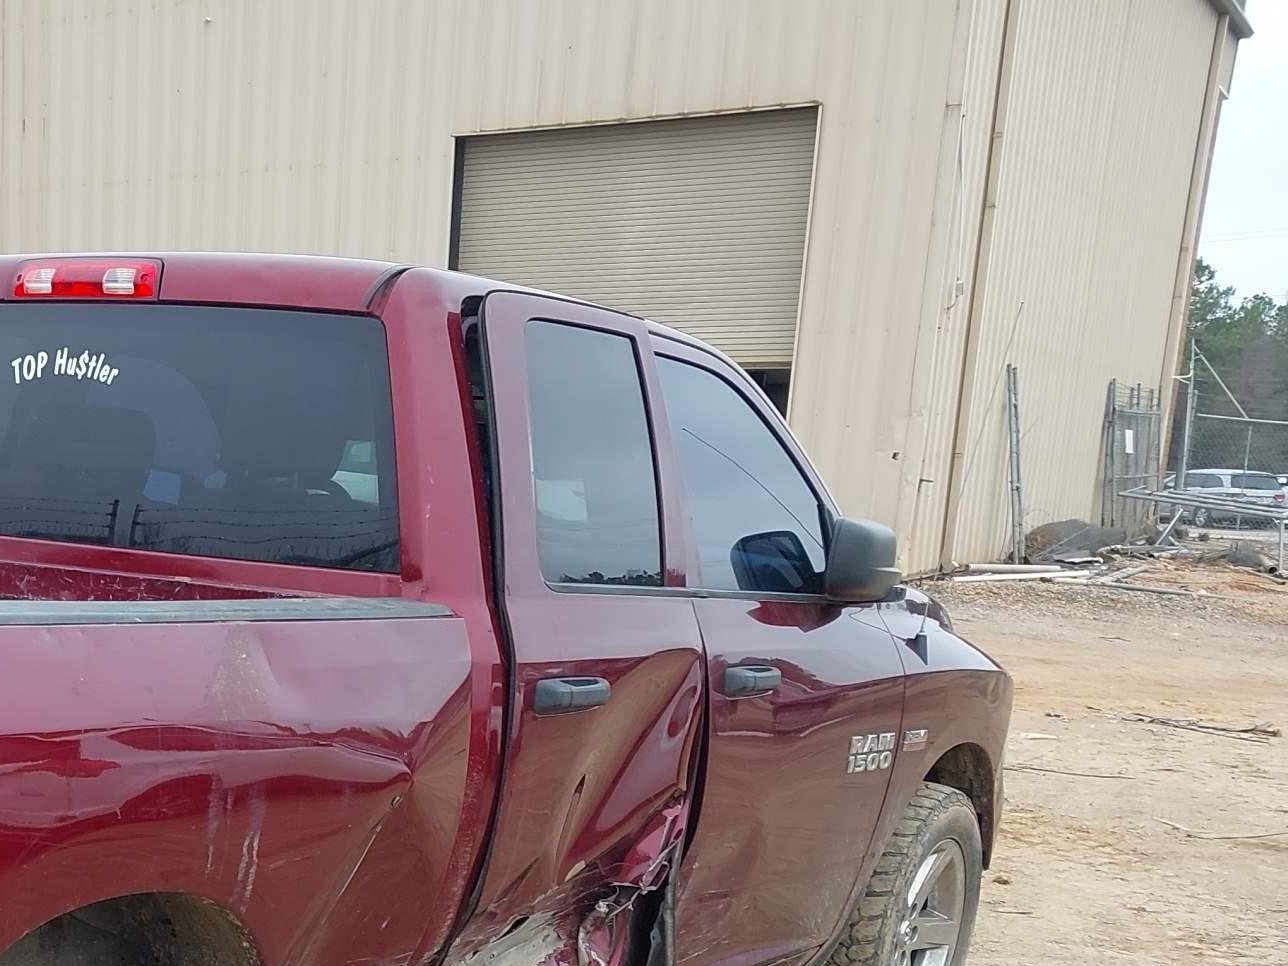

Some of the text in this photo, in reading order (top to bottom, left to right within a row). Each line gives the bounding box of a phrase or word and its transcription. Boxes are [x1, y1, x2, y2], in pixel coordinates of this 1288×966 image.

[12, 347, 119, 385] TOP Hu$tler
[849, 732, 896, 755] RAM
[847, 751, 892, 774] 1500
